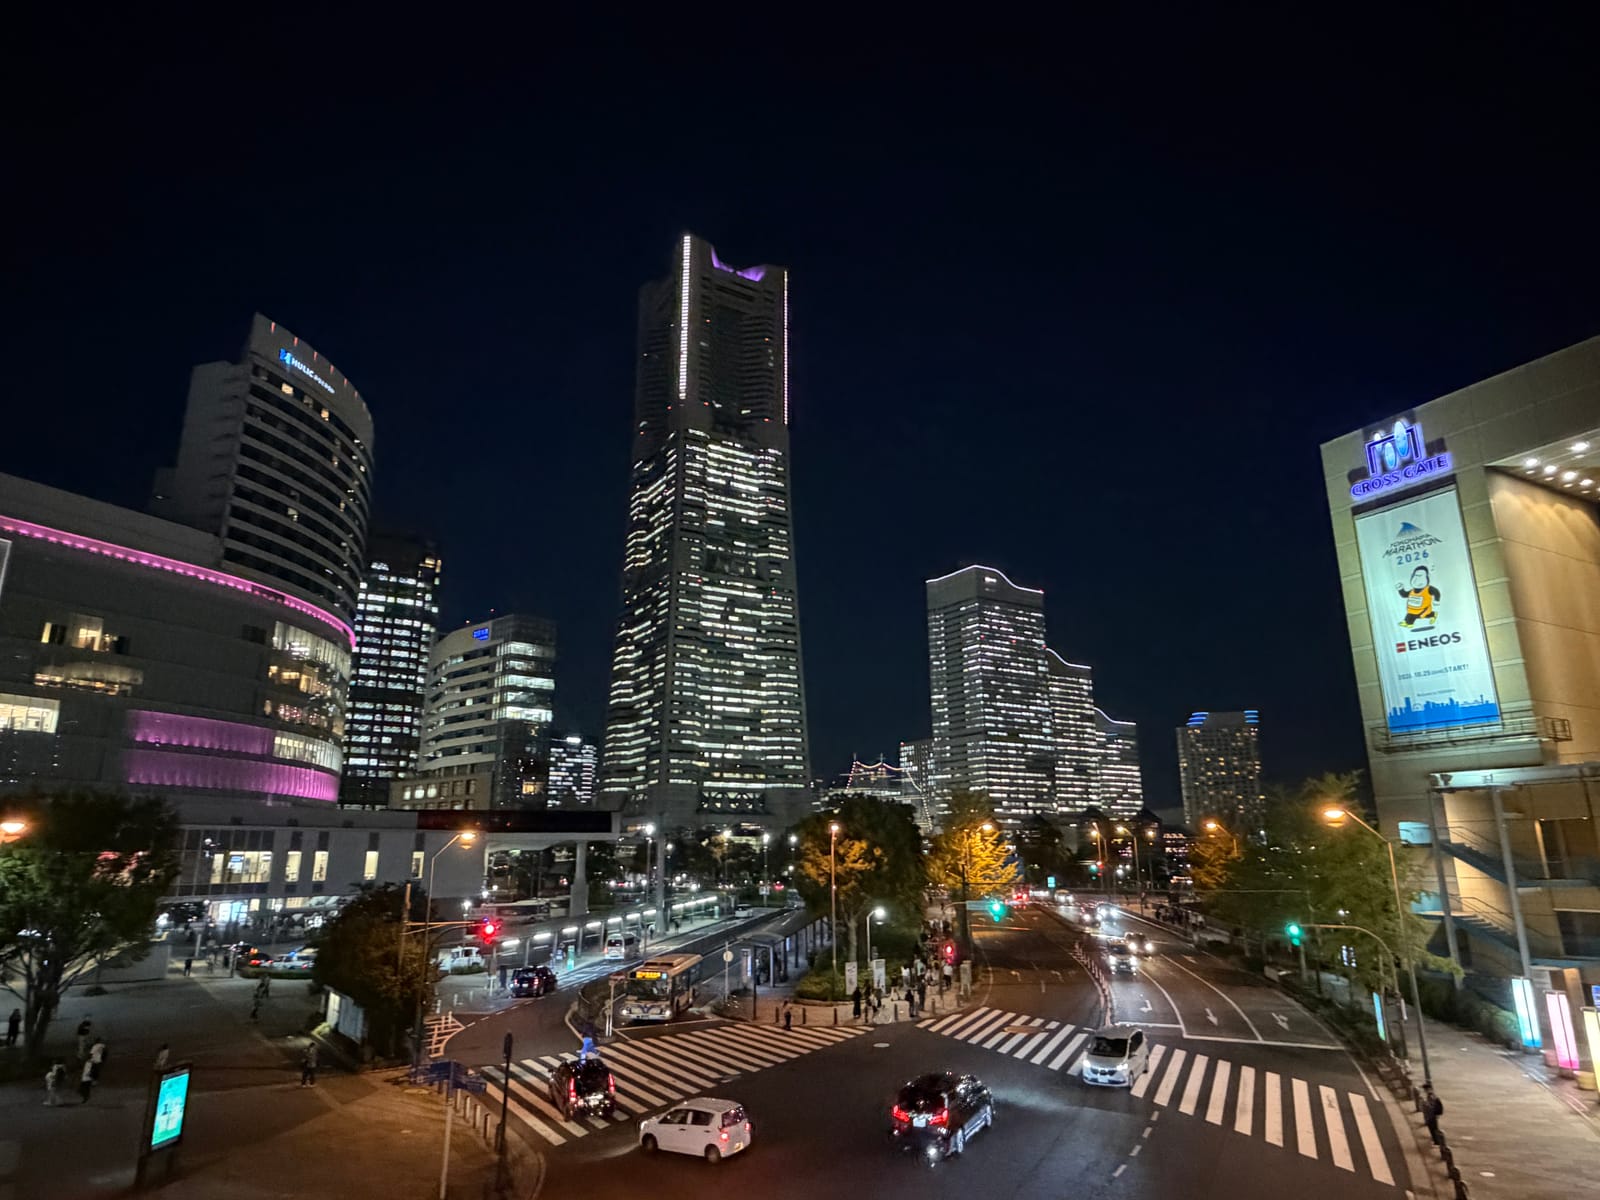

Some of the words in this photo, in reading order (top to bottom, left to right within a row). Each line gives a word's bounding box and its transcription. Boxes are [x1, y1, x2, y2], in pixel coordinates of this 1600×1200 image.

[291, 357, 315, 378] HULIC
[1351, 472, 1401, 497] CROSS
[1403, 455, 1448, 479] GATE
[1382, 537, 1443, 559] MARATHON
[1396, 548, 1429, 566] 2026
[1407, 631, 1462, 651] ENEOS
